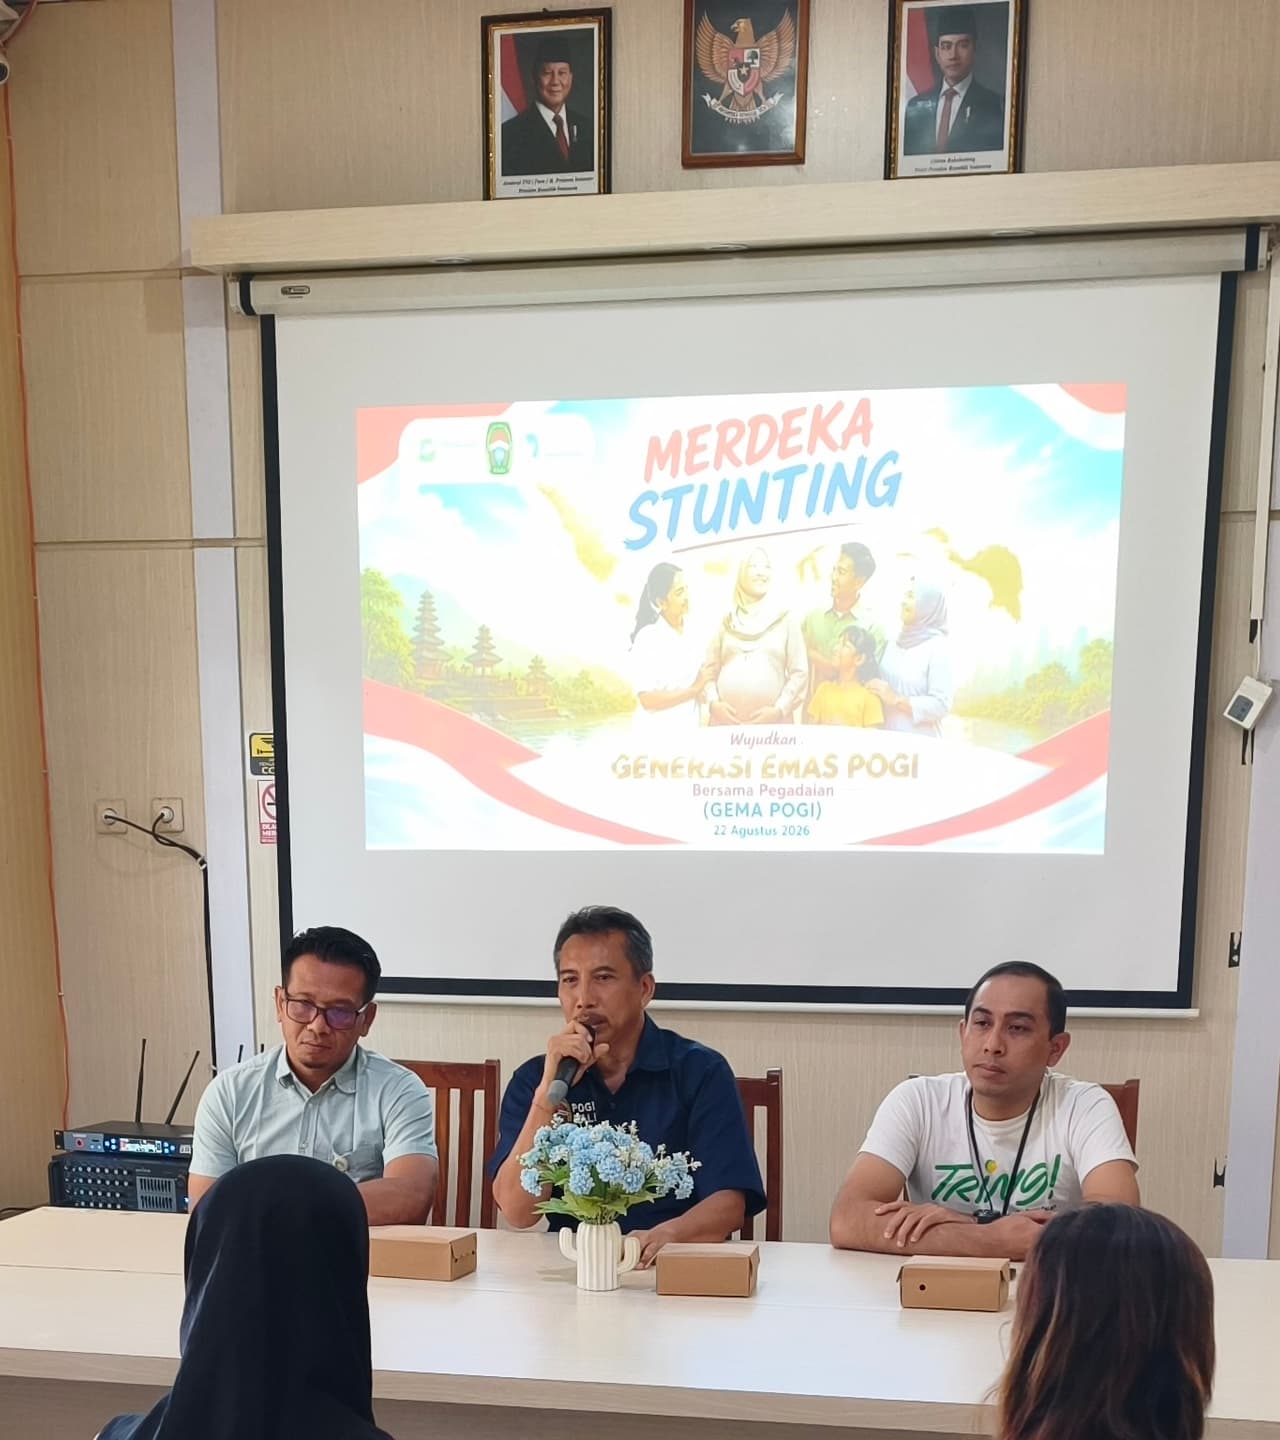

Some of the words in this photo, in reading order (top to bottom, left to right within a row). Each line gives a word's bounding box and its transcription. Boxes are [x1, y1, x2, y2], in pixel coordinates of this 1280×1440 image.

[643, 397, 874, 485] MERDEKA
[622, 450, 904, 552] STUNTING
[729, 731, 798, 749] Wujudkan
[610, 754, 753, 780] GENERASI
[760, 753, 839, 779] EMAS
[847, 751, 919, 779] POGI
[692, 783, 755, 798] Bersama
[758, 783, 835, 800] Pegadaian
[703, 800, 763, 821] (GEMA
[769, 800, 822, 821] POGI)
[713, 825, 727, 837] 22
[730, 824, 778, 839] Agustus
[781, 825, 811, 837] 2026
[570, 1100, 596, 1113] POGI
